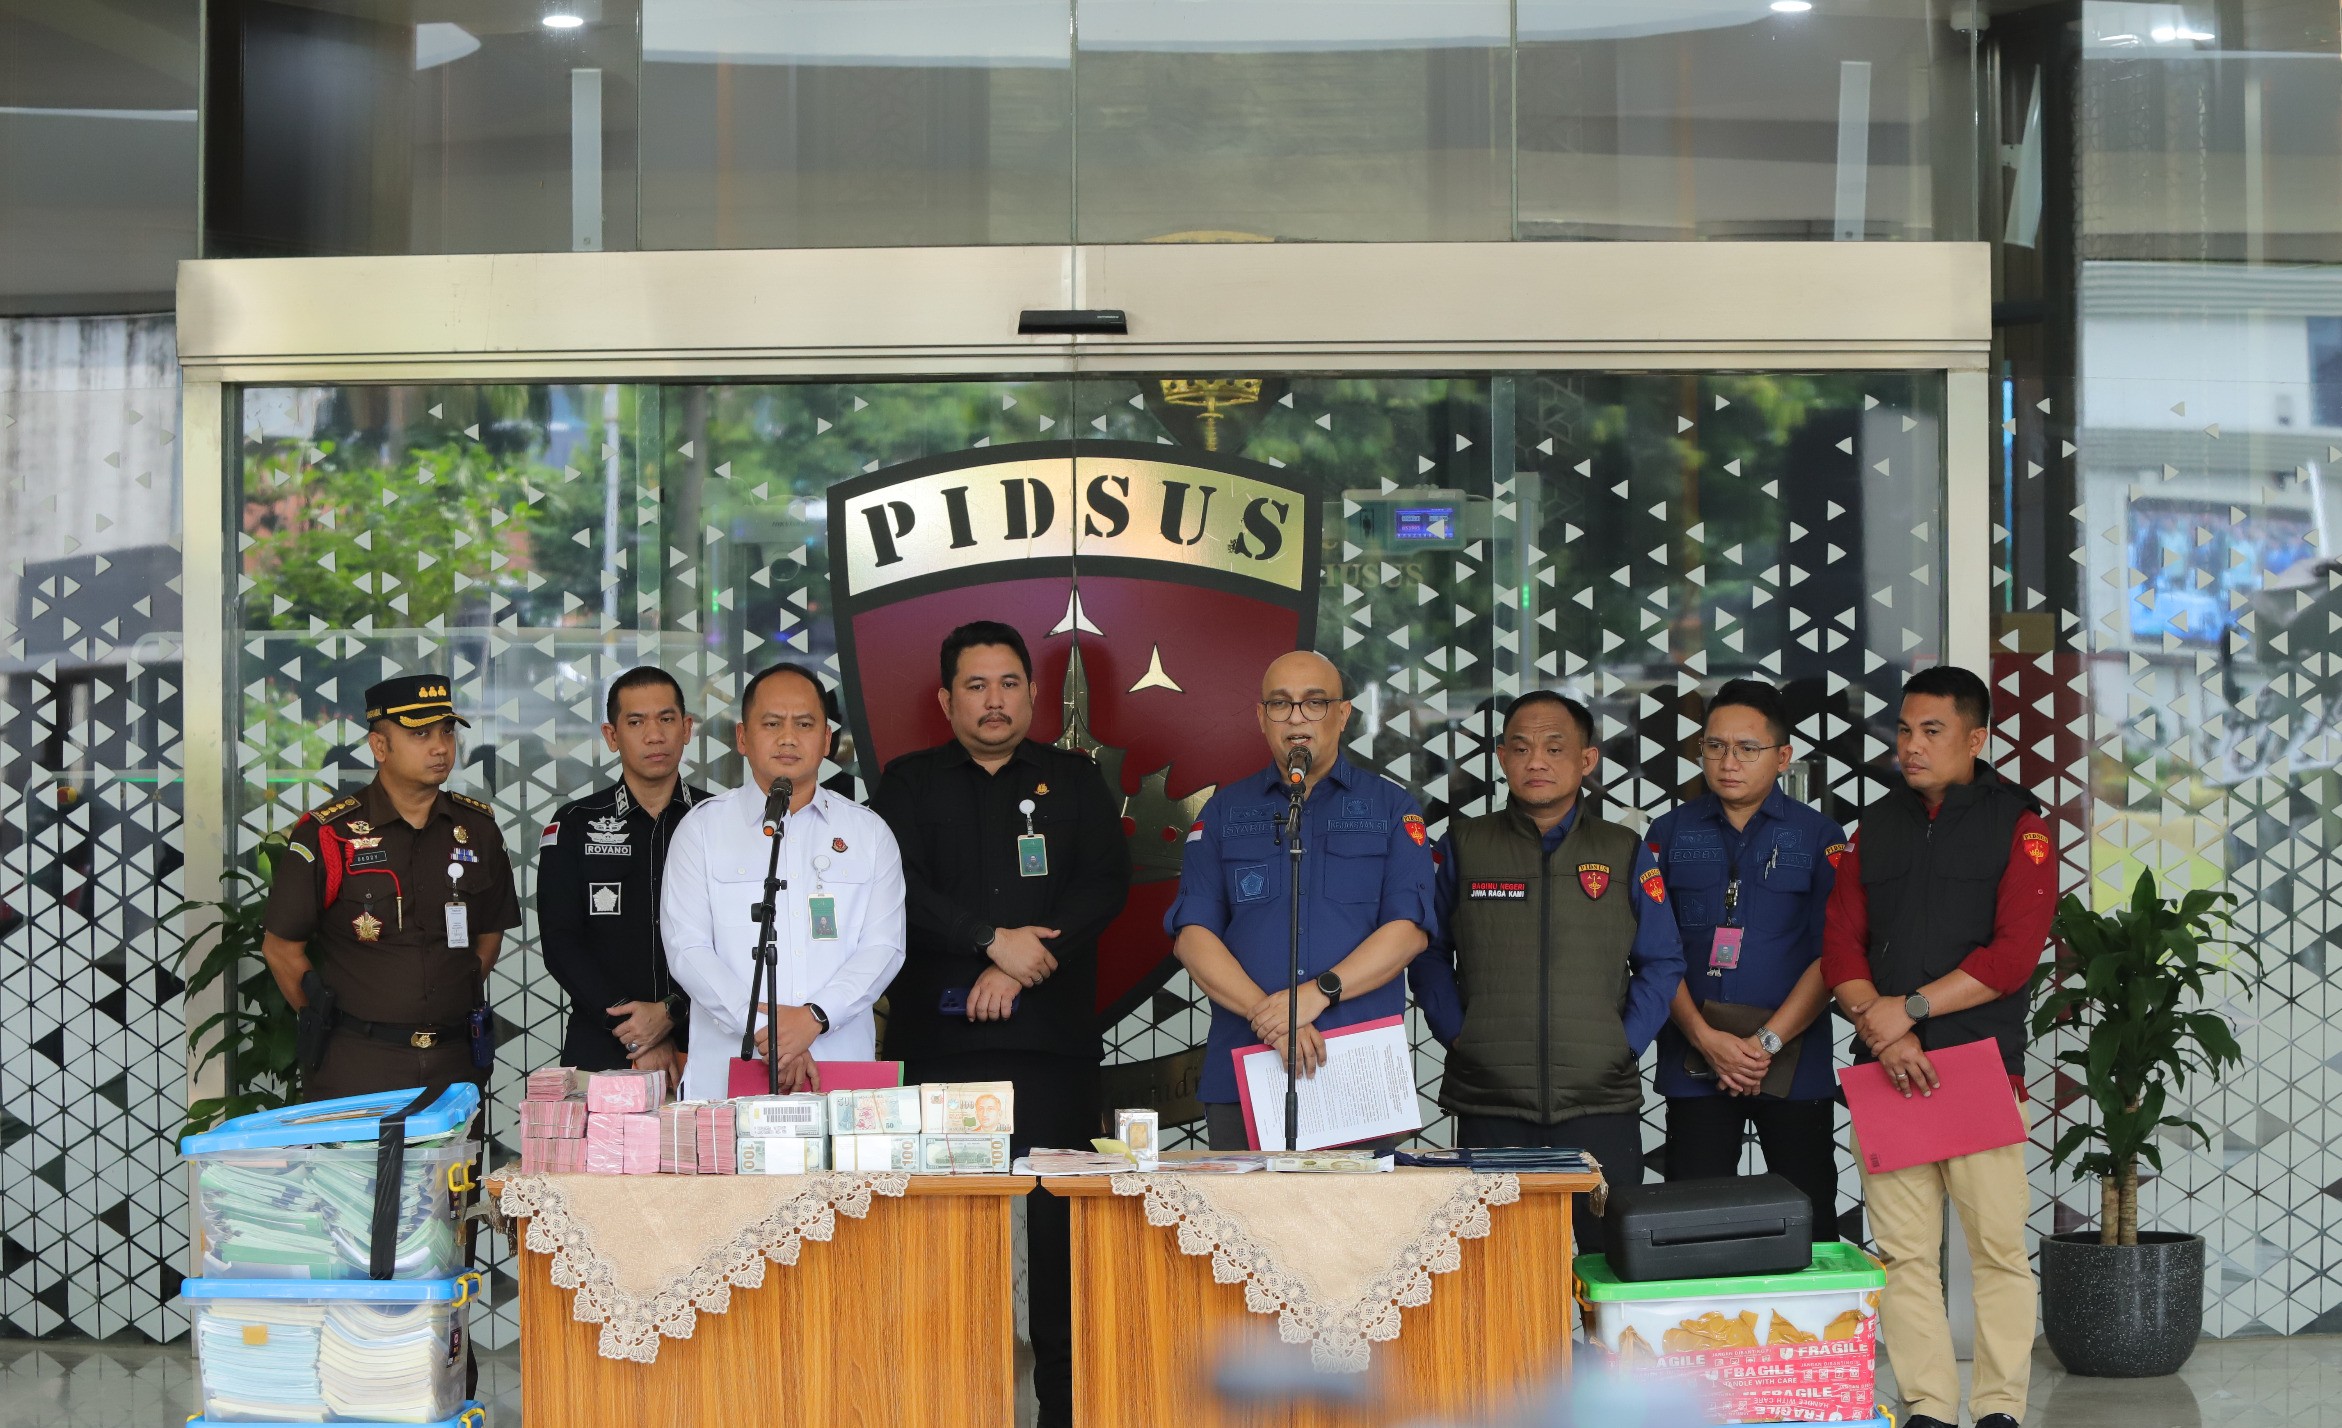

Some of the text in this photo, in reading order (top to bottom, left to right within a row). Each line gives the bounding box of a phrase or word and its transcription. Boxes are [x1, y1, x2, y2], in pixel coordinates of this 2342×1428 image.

[860, 474, 1290, 568] PIDSUS
[587, 845, 629, 854] ROVANO
[1673, 850, 1719, 860] BOBBY
[1579, 864, 1609, 872] PIDSUS
[1470, 890, 1525, 898] JIWA RAGA KAMI
[1499, 883, 1525, 891] NEGERI
[743, 1143, 755, 1170] 100
[901, 1140, 914, 1166] 100
[991, 1140, 1004, 1165] 100
[1798, 1343, 1869, 1357] FRAGILE
[1656, 1354, 1706, 1368] AGILE
